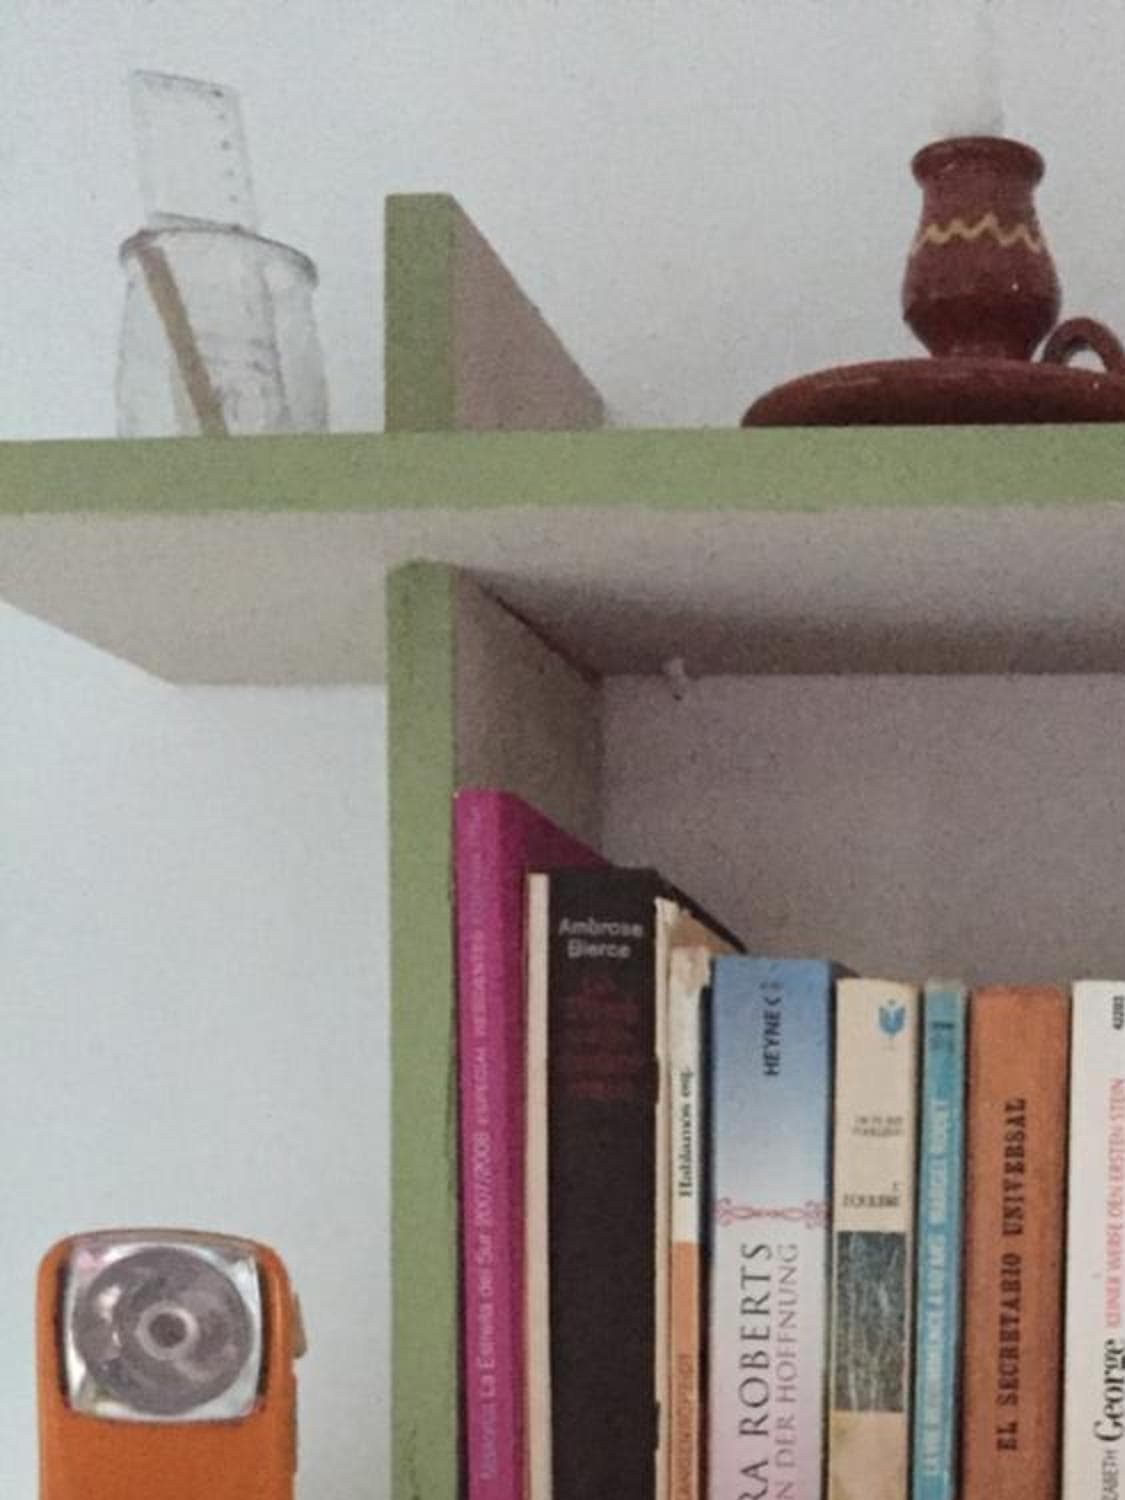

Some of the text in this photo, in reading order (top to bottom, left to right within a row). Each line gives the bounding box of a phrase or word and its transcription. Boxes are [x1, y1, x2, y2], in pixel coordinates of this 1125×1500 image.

[558, 917, 644, 938] Ambrose
[567, 938, 631, 959] Bierce
[763, 1008, 782, 1077] HEYNE
[678, 1103, 693, 1198] Hablamos
[1109, 1127, 1125, 1181] ERSTEN
[1109, 1185, 1125, 1218] DEN
[997, 1098, 1027, 1452] EL SECRETARIO UNIVERSAL
[737, 1242, 772, 1438] ROBERTS
[776, 1243, 799, 1403] HOFFNUNG
[775, 1411, 797, 1468] DER
